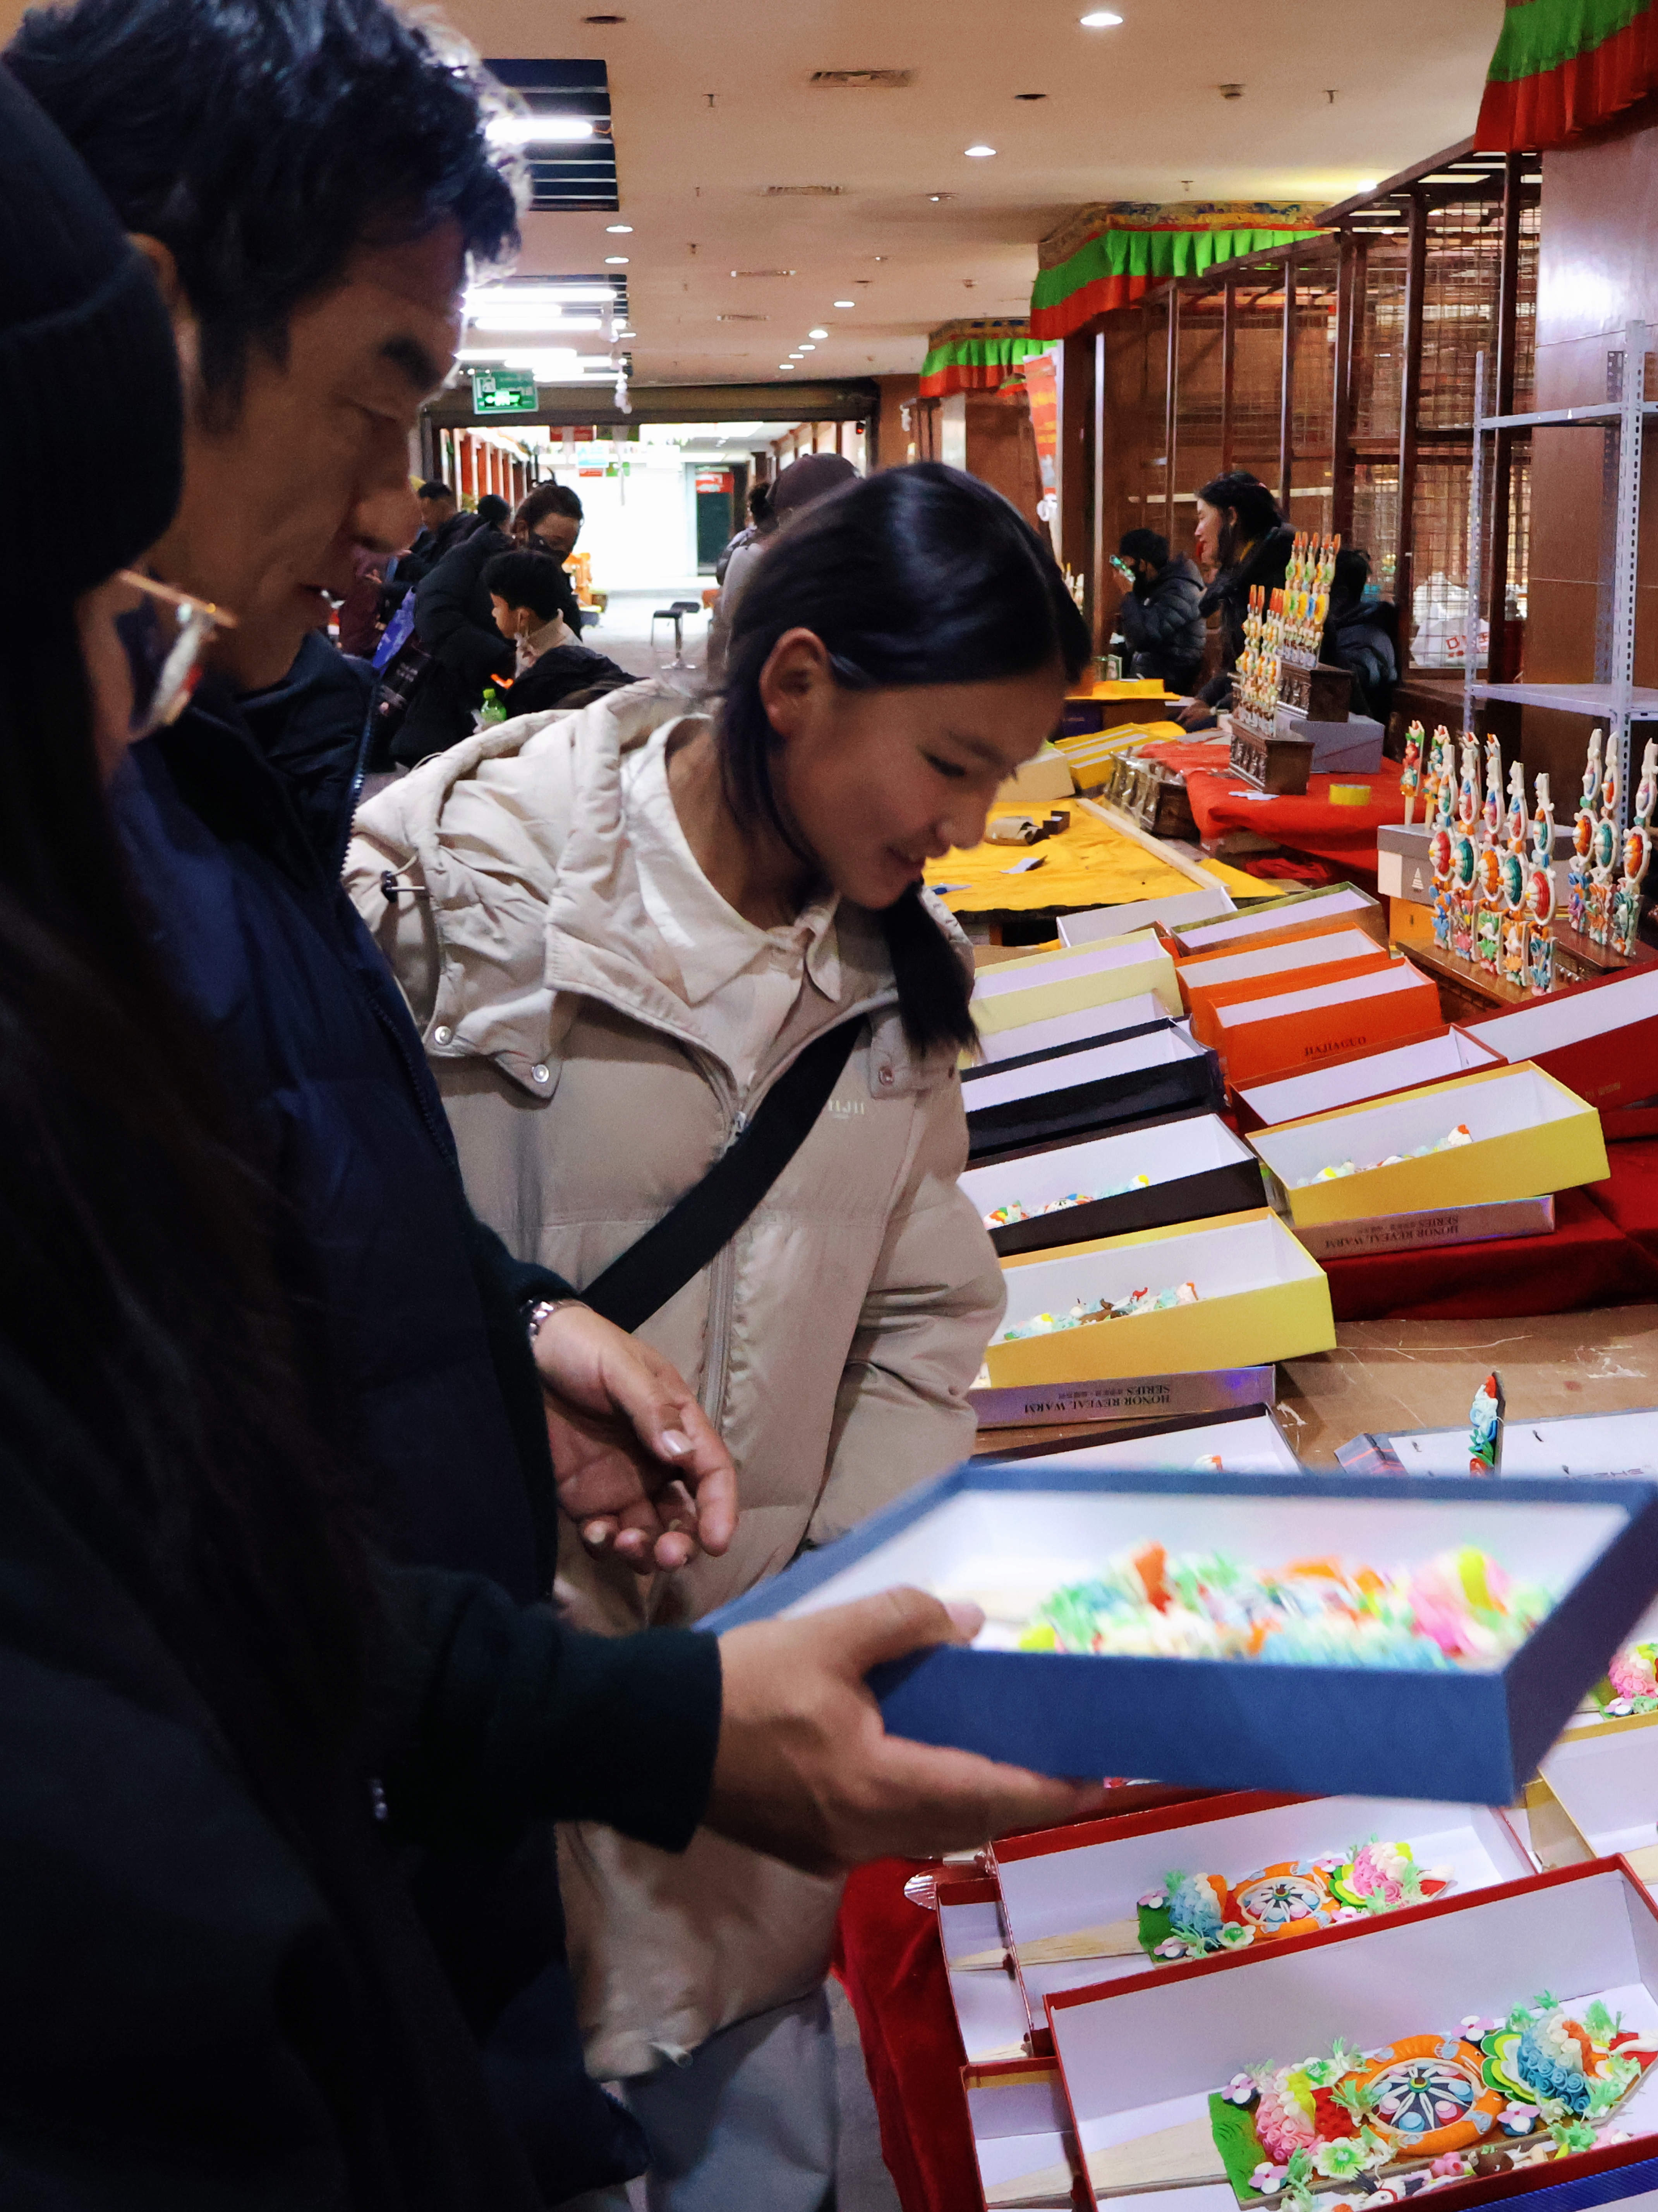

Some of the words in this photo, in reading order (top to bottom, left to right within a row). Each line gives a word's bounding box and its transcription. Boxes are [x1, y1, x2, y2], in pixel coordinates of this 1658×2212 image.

[1419, 1216, 1459, 1228] SERIES
[1370, 1231, 1413, 1243] REVEAL
[1418, 1226, 1458, 1238] HONOR
[1325, 1238, 1363, 1248] WARM
[1126, 1385, 1170, 1395] SERIES
[1071, 1398, 1120, 1410] REVEAL
[1125, 1395, 1170, 1405] HONOR
[1025, 1402, 1066, 1413] WARM
